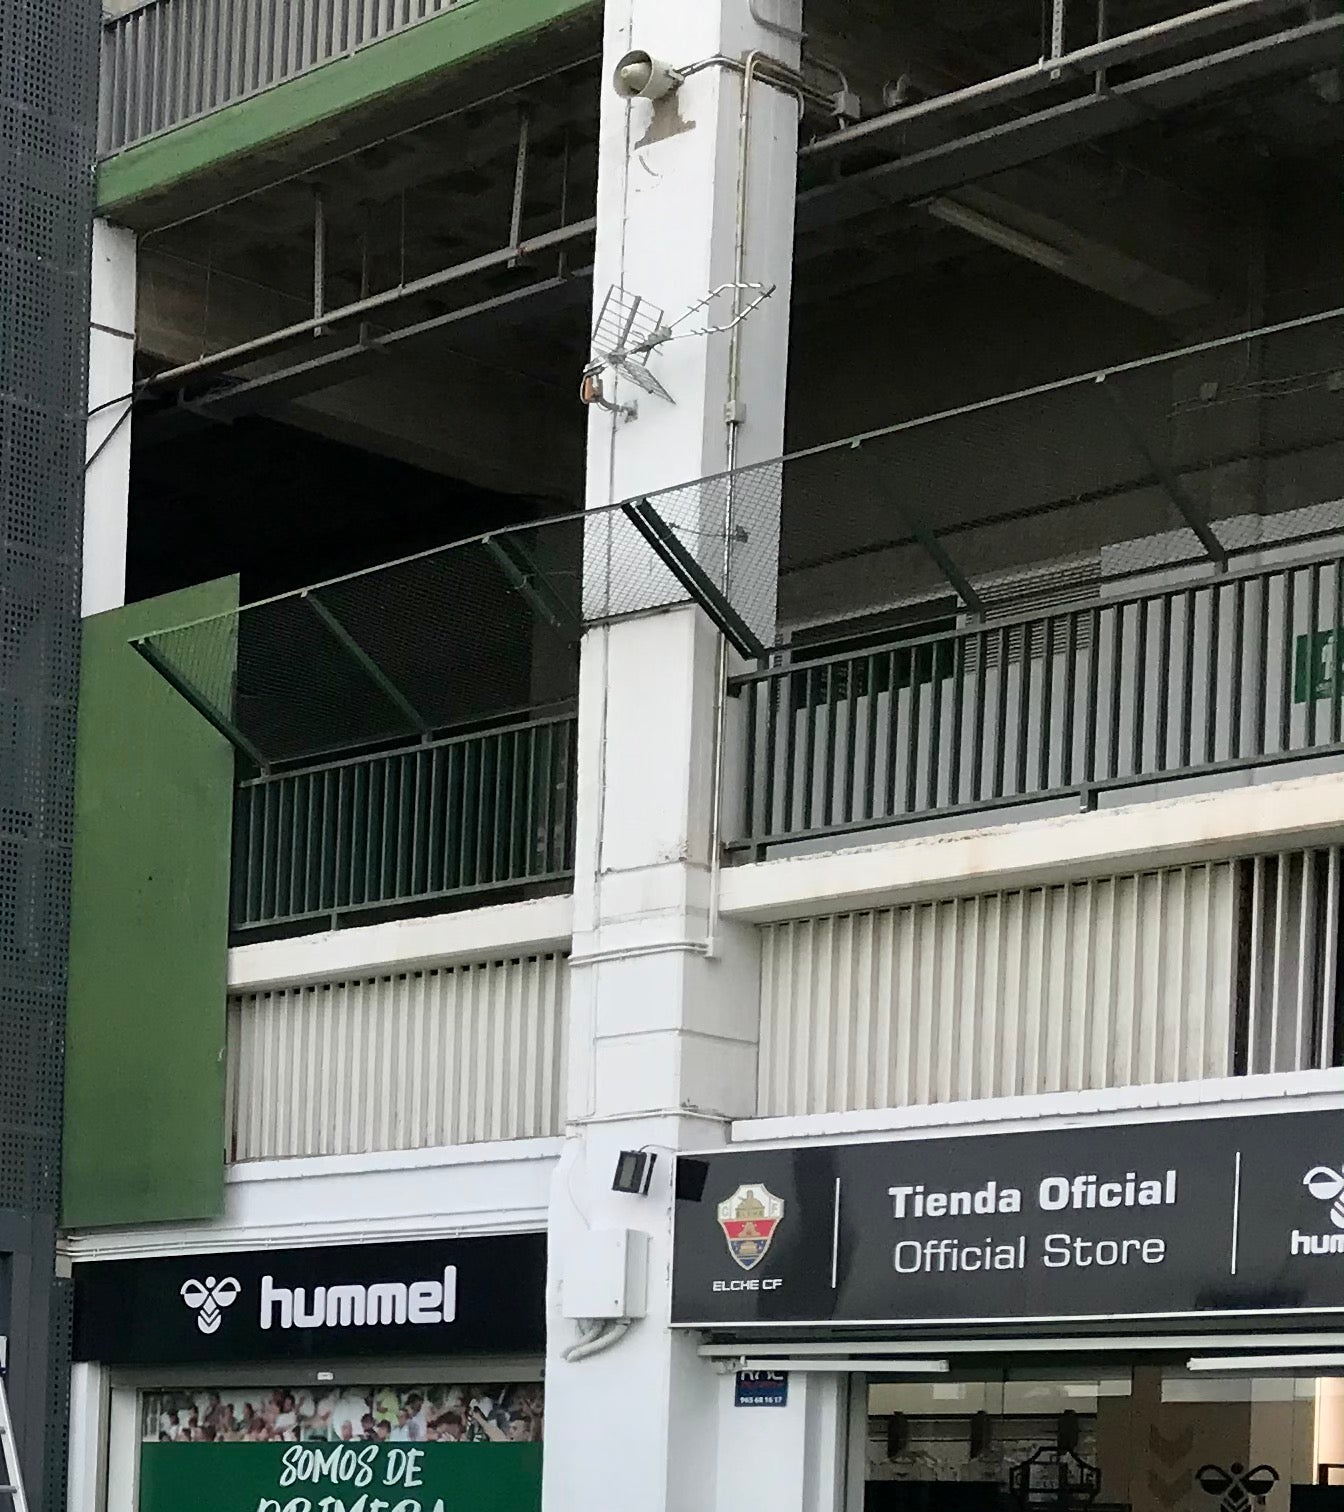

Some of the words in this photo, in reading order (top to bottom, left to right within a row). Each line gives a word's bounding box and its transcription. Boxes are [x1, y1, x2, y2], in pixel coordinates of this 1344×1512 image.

[888, 1182, 1021, 1219] Tienda
[1039, 1170, 1177, 1211] Oficial
[893, 1236, 1026, 1275] Official
[1042, 1233, 1166, 1268] Store
[260, 1265, 457, 1330] hummel
[712, 1279, 759, 1291] ELCHE
[762, 1278, 783, 1290] CF
[279, 1444, 375, 1487] SOMOS
[382, 1447, 424, 1487] DE
